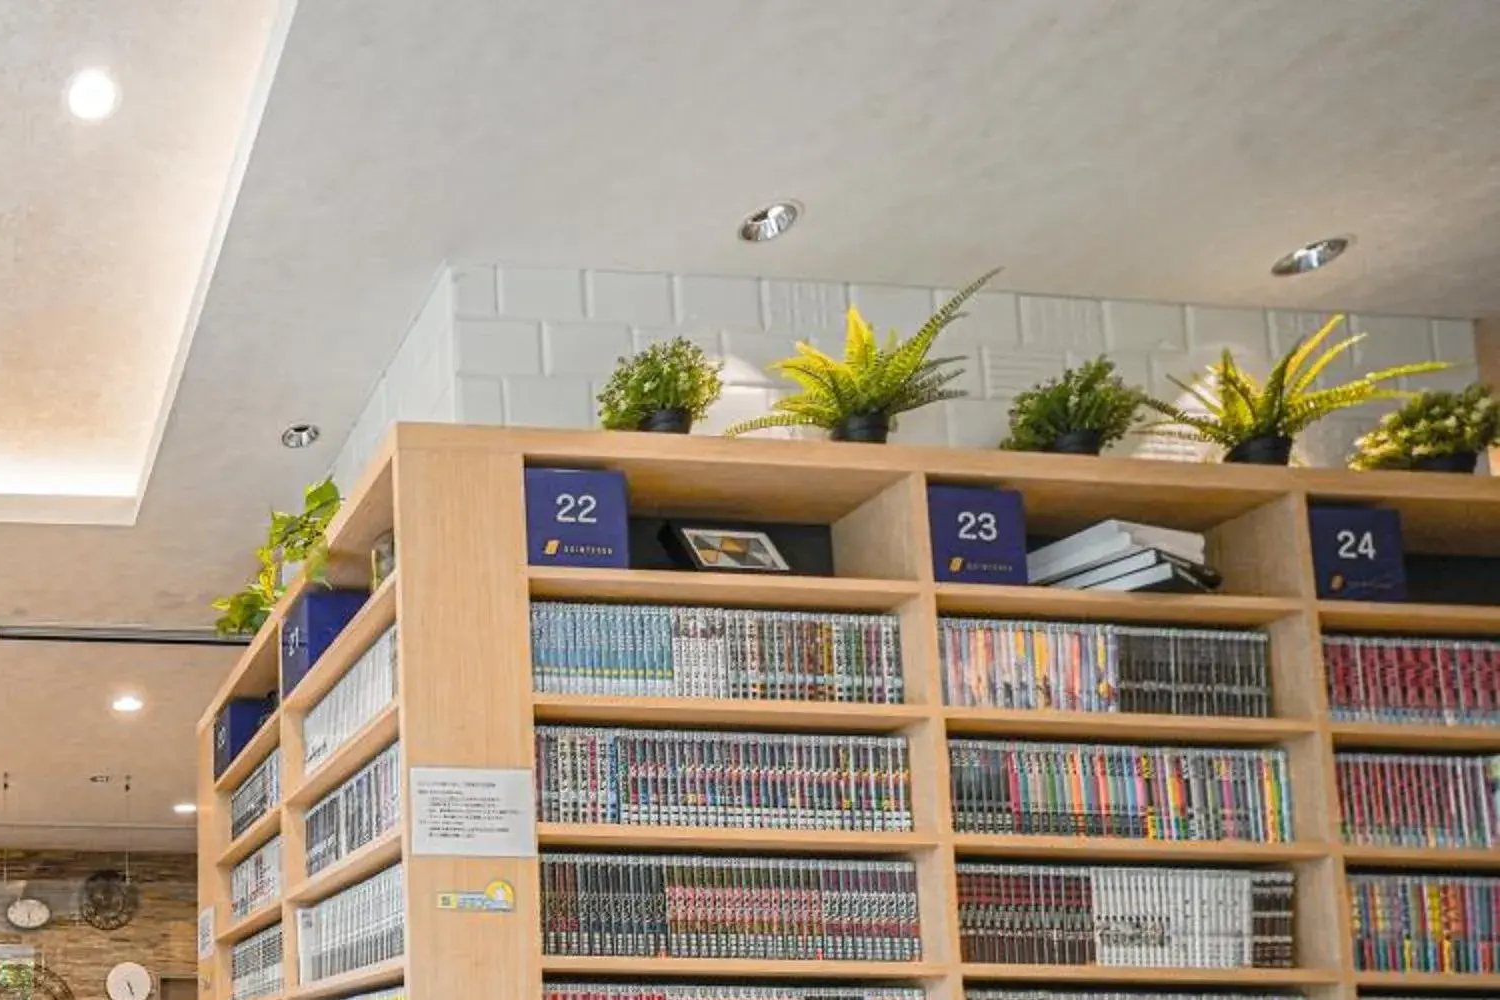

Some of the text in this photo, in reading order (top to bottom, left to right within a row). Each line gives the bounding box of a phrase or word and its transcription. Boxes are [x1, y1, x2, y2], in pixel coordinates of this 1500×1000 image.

[556, 493, 597, 523] 22
[957, 511, 998, 541] 23
[1336, 530, 1377, 560] 24
